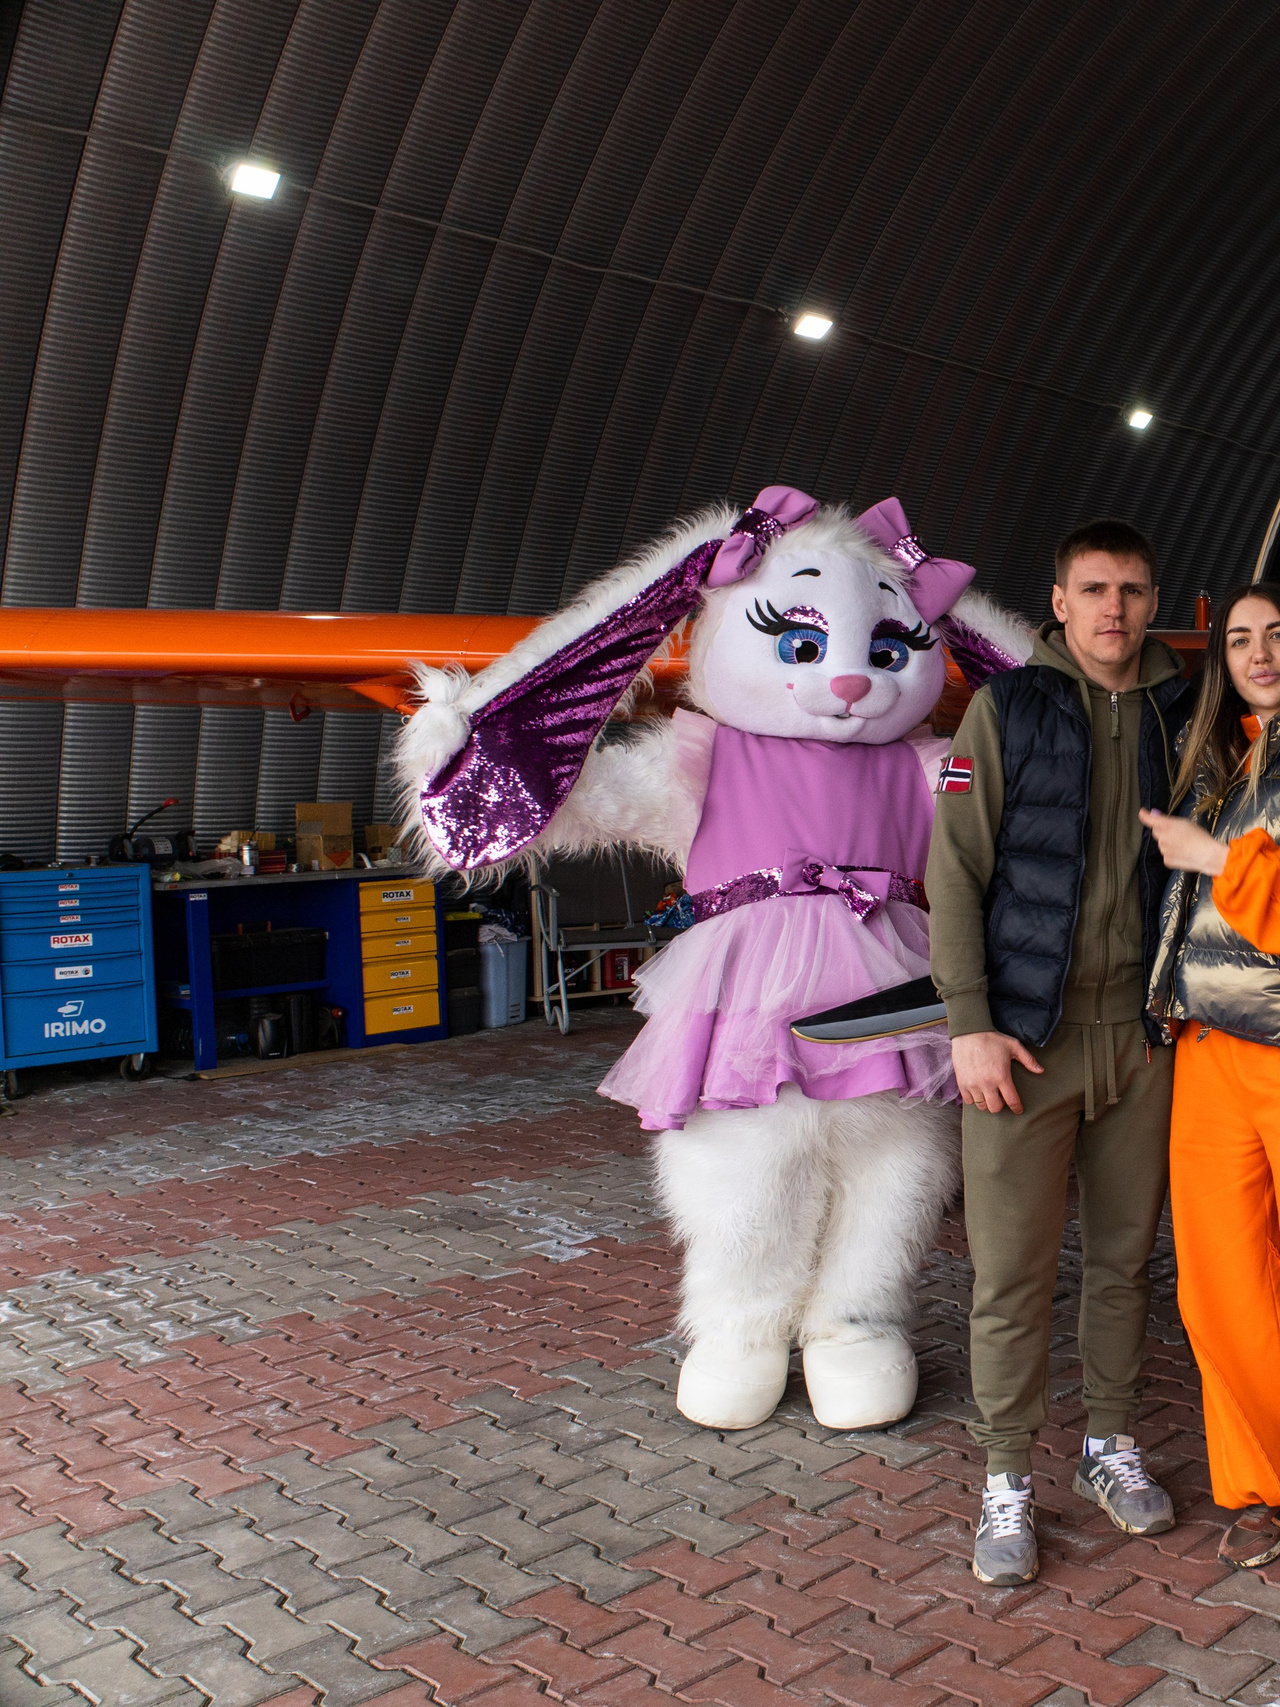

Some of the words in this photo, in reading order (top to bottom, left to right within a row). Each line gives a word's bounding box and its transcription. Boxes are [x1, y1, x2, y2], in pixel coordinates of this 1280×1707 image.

[382, 890, 412, 899] ROTAX
[52, 934, 90, 944] ROTAX
[44, 1018, 106, 1038] IRIMO
